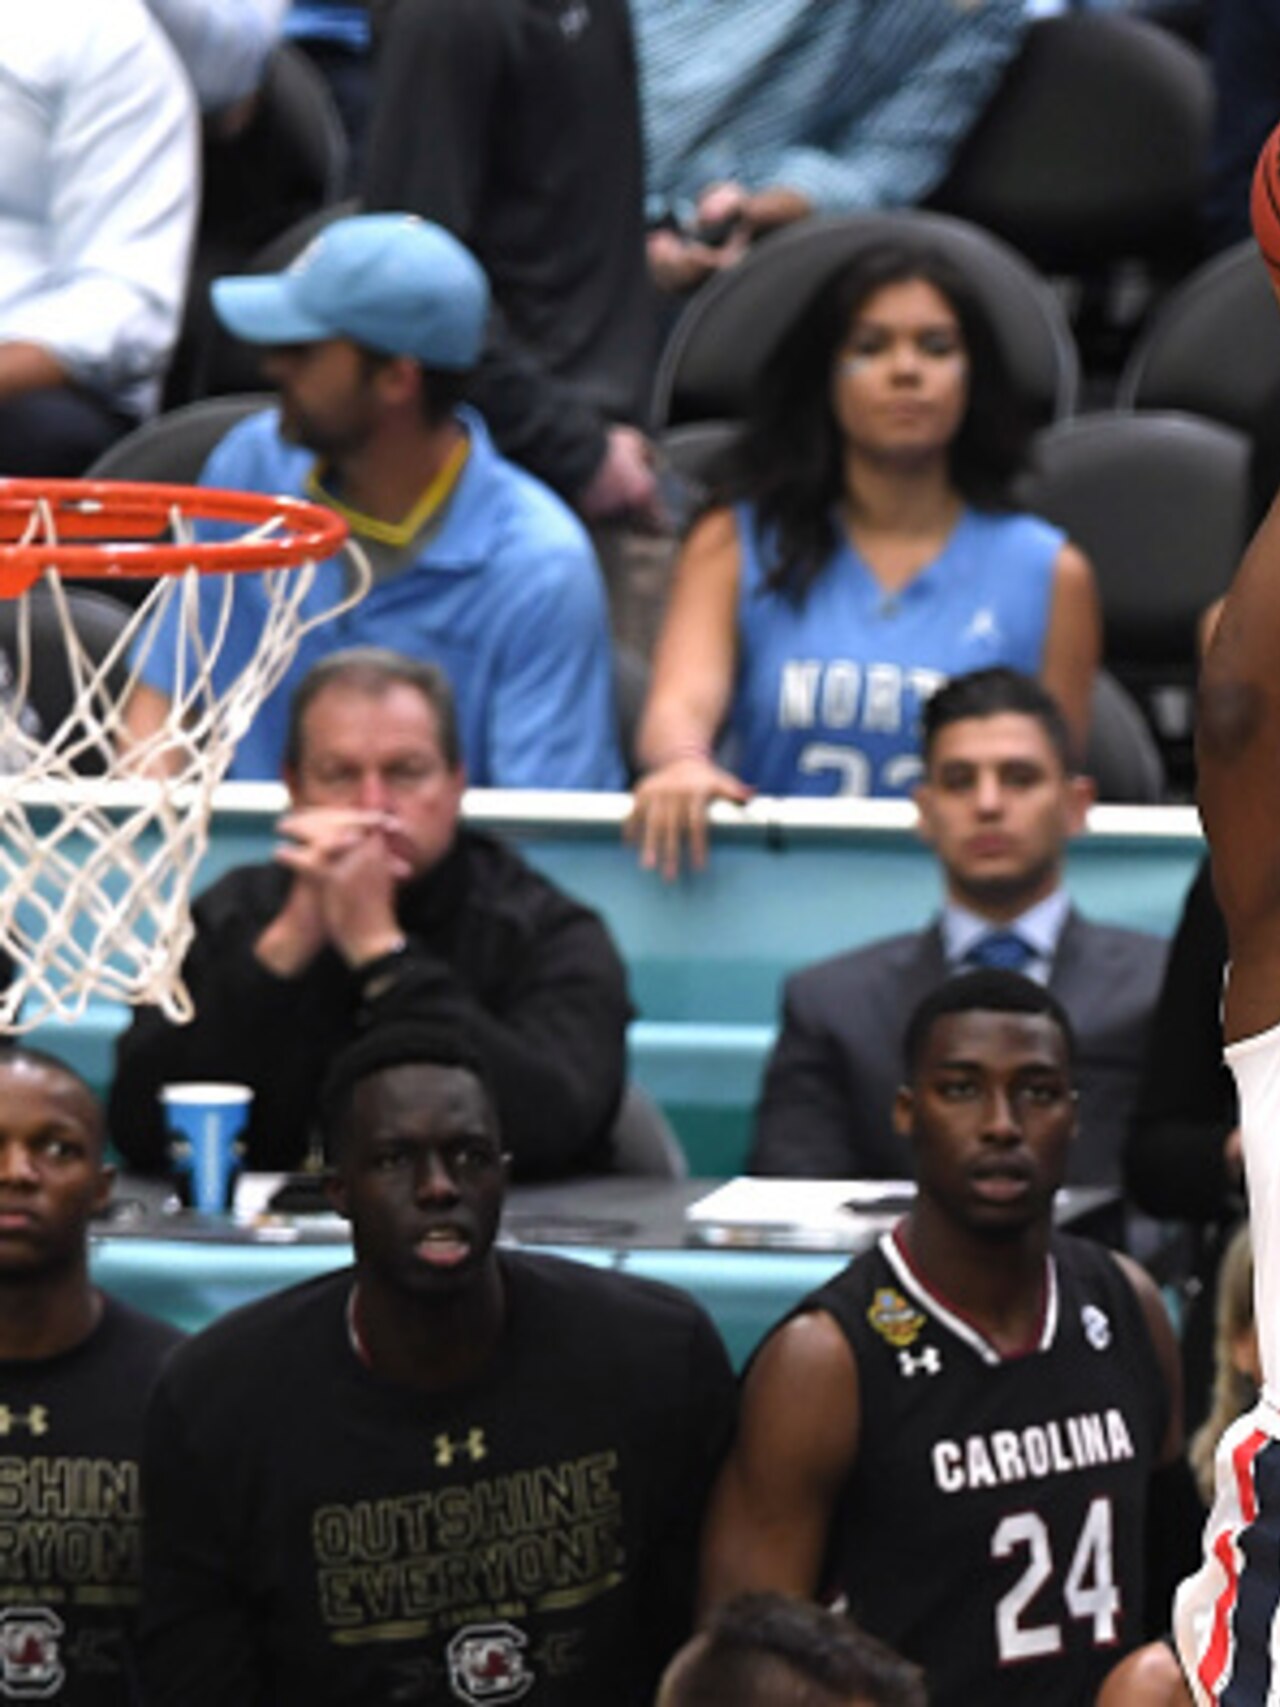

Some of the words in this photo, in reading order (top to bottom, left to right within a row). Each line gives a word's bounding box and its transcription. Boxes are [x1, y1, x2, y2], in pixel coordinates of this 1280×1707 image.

[931, 1408, 1135, 1493] CAROLINA
[313, 1449, 620, 1566] OUTSHINE
[317, 1520, 625, 1625] EVERYONE
[991, 1496, 1123, 1662] 24
